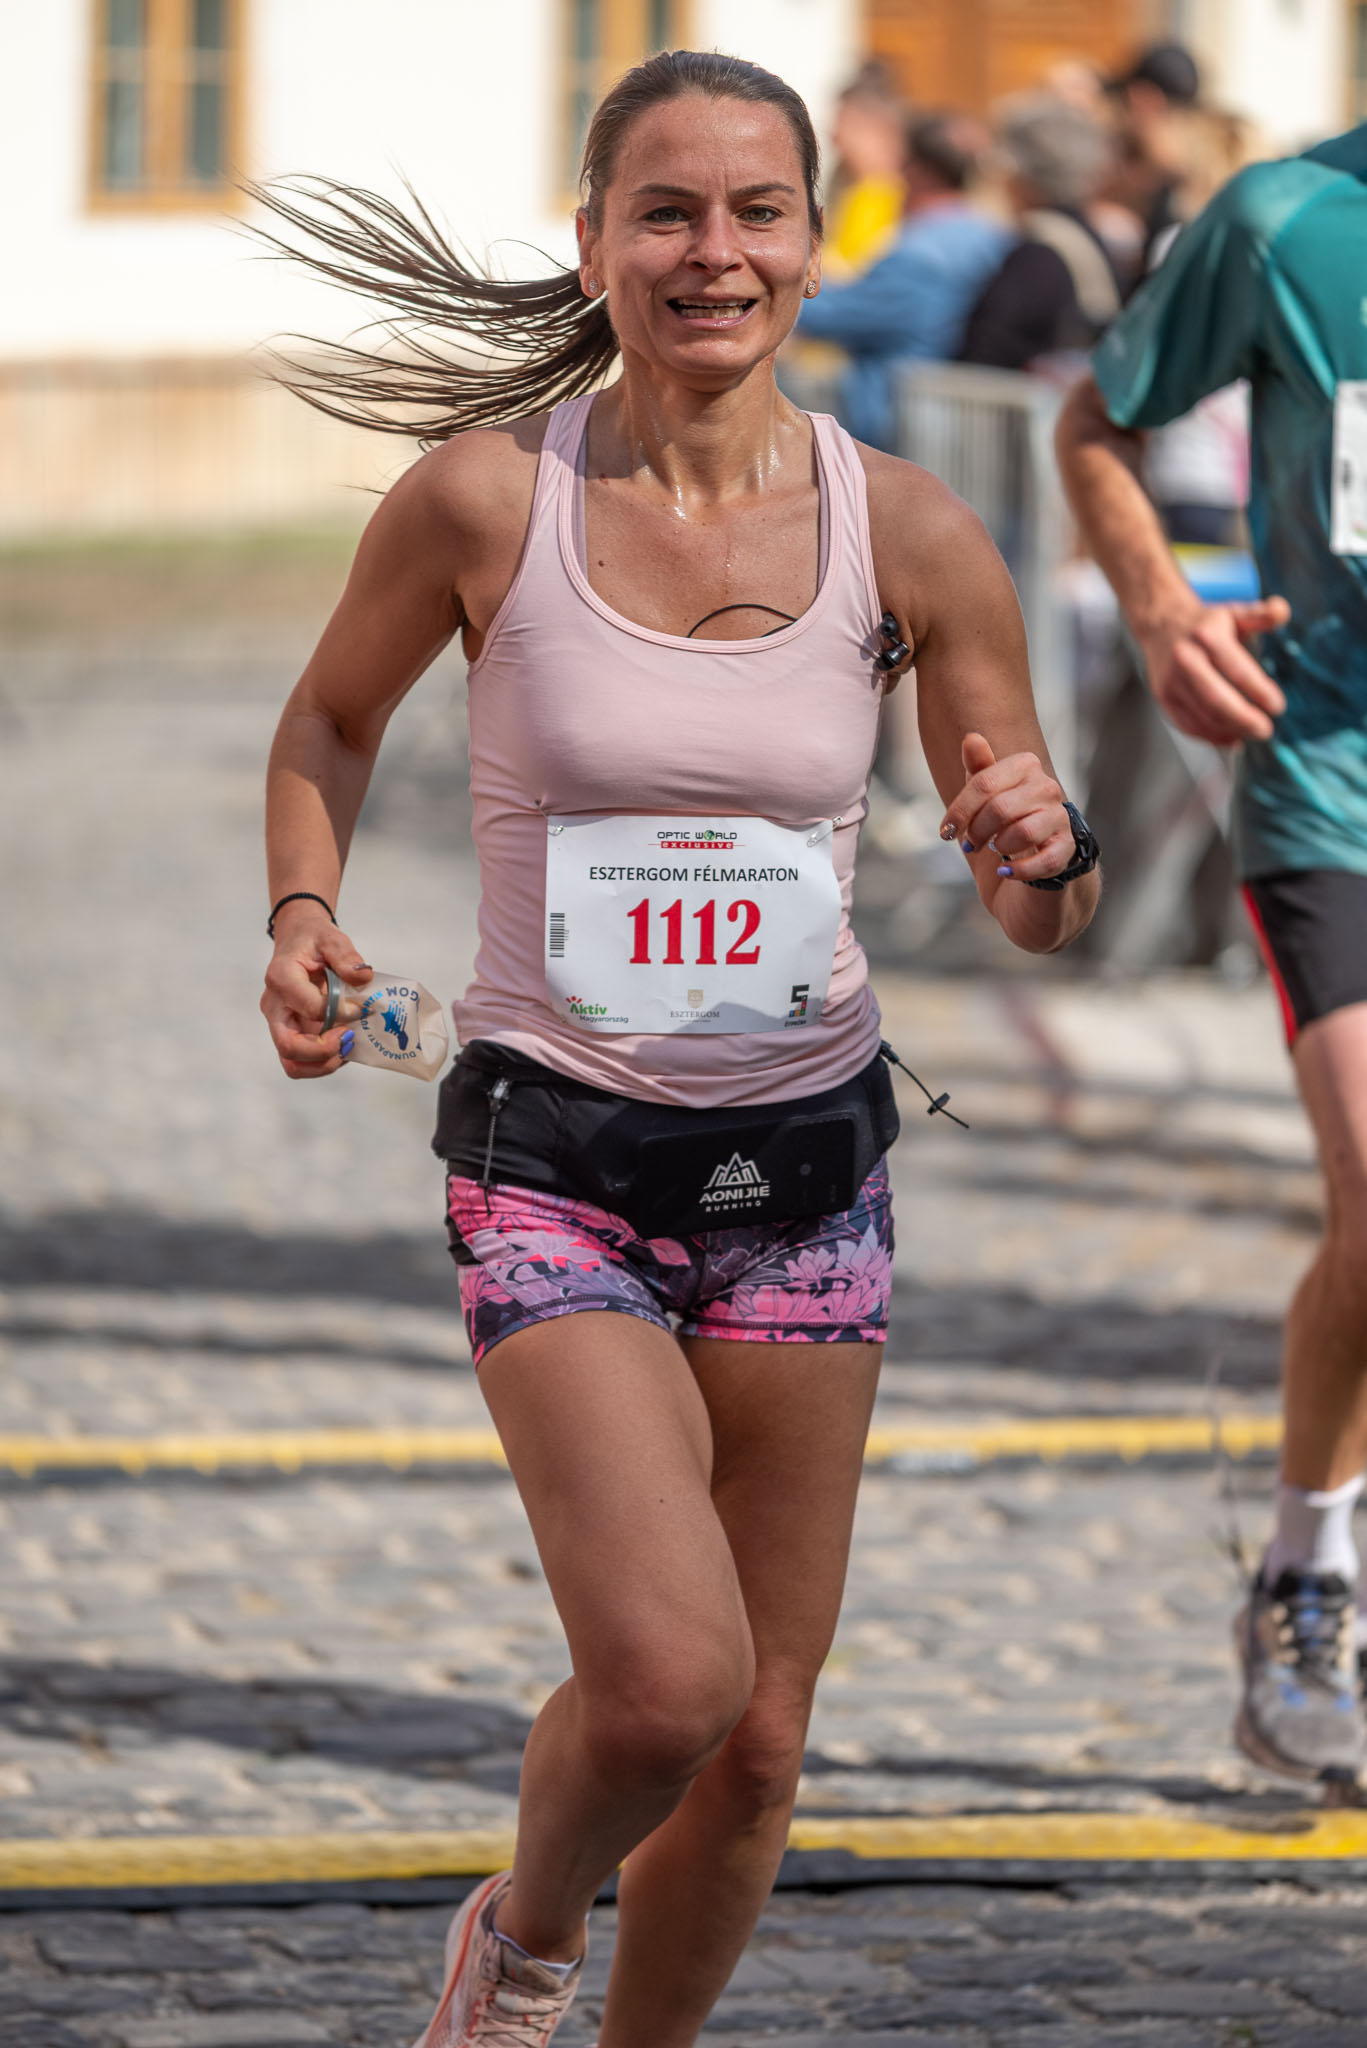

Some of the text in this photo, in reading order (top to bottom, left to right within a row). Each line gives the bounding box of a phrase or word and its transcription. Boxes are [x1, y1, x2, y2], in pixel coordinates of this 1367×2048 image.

[657, 829, 738, 841] OPTIC WORLD
[589, 864, 799, 882] ESZTERGOM FÉLMARATON
[627, 898, 761, 965] 1112
[570, 1003, 607, 1015] Aktiv
[670, 1010, 720, 1018] ESZTERGOM
[699, 1185, 770, 1203] AONIJIE
[705, 1200, 761, 1212] RUNNING
